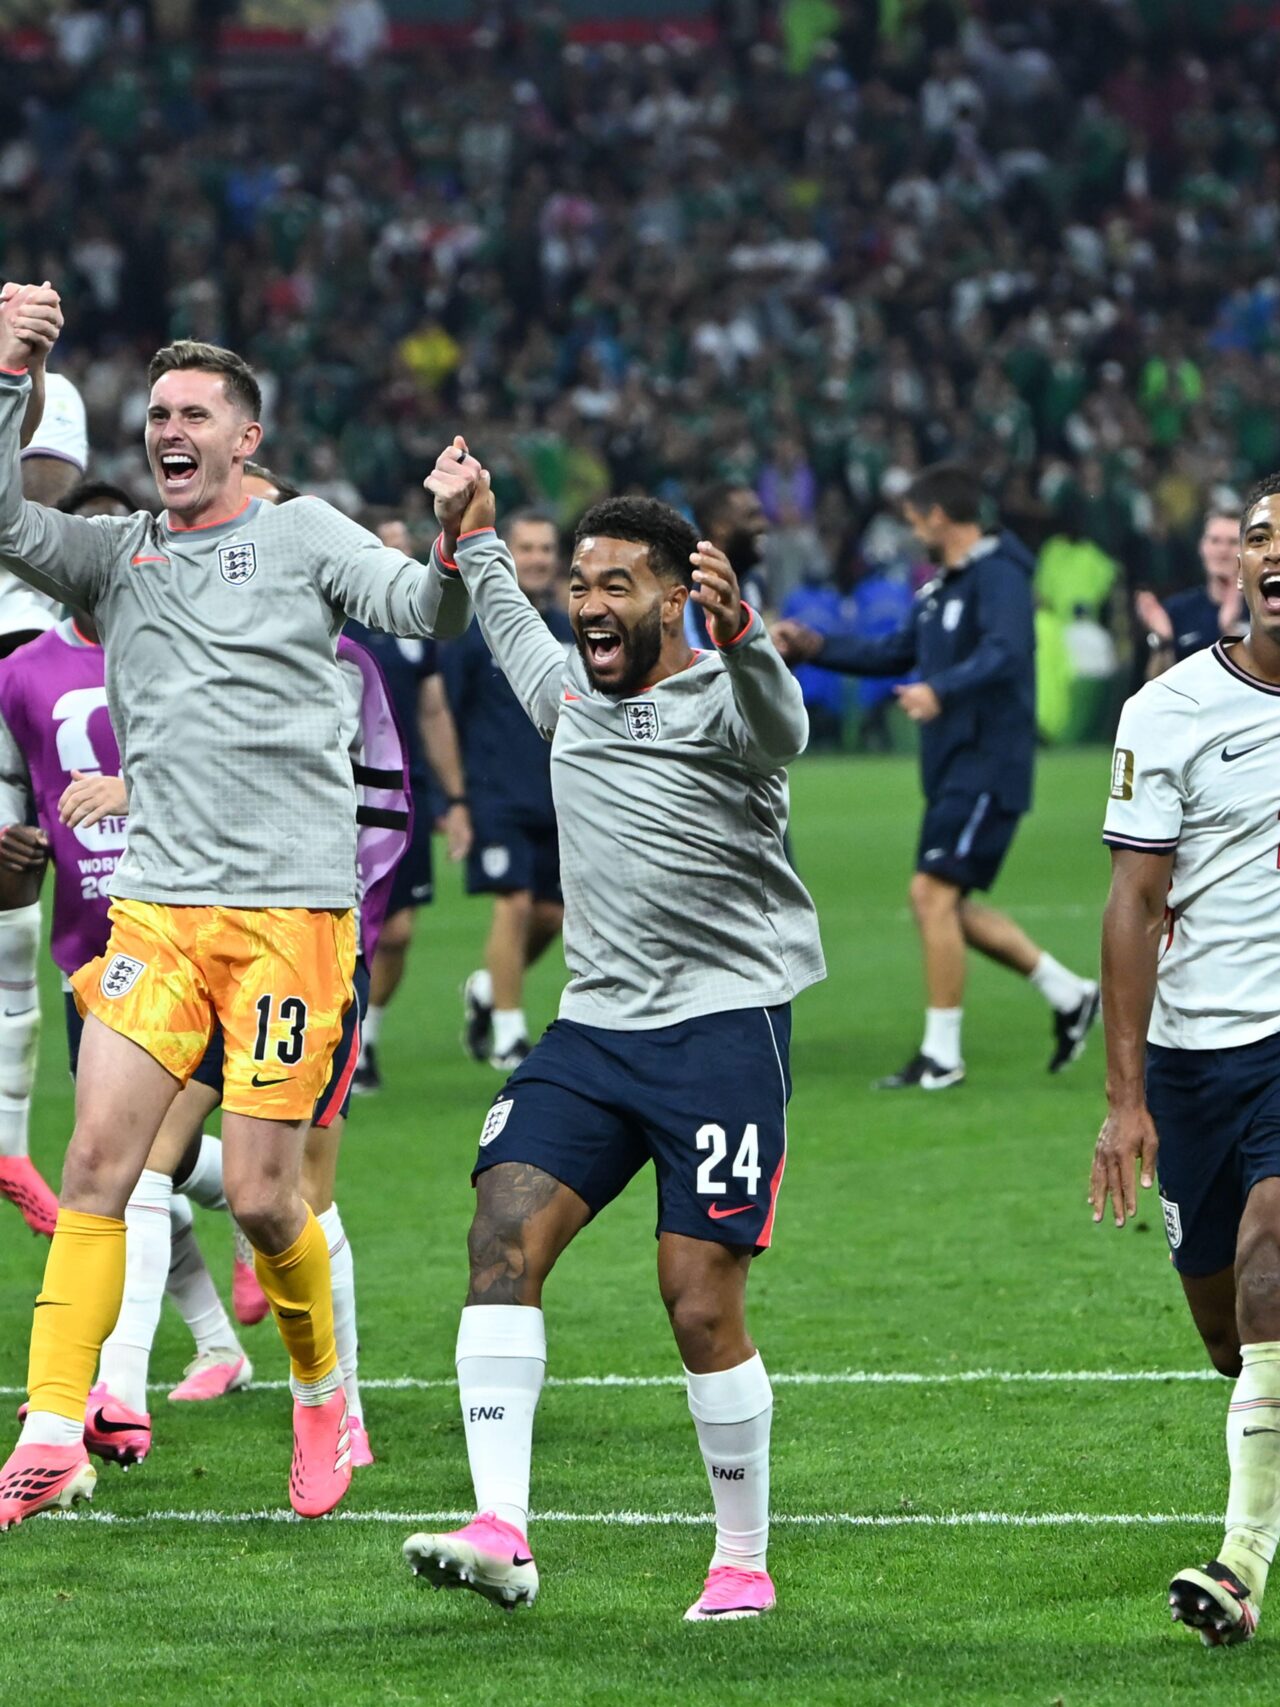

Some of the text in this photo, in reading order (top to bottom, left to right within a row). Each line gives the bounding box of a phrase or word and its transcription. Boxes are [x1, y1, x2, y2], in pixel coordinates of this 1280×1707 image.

[98, 816, 127, 835] FIF
[253, 993, 307, 1066] 13
[695, 1122, 762, 1195] 24
[469, 1406, 505, 1422] ENG
[711, 1465, 745, 1481] ENG
